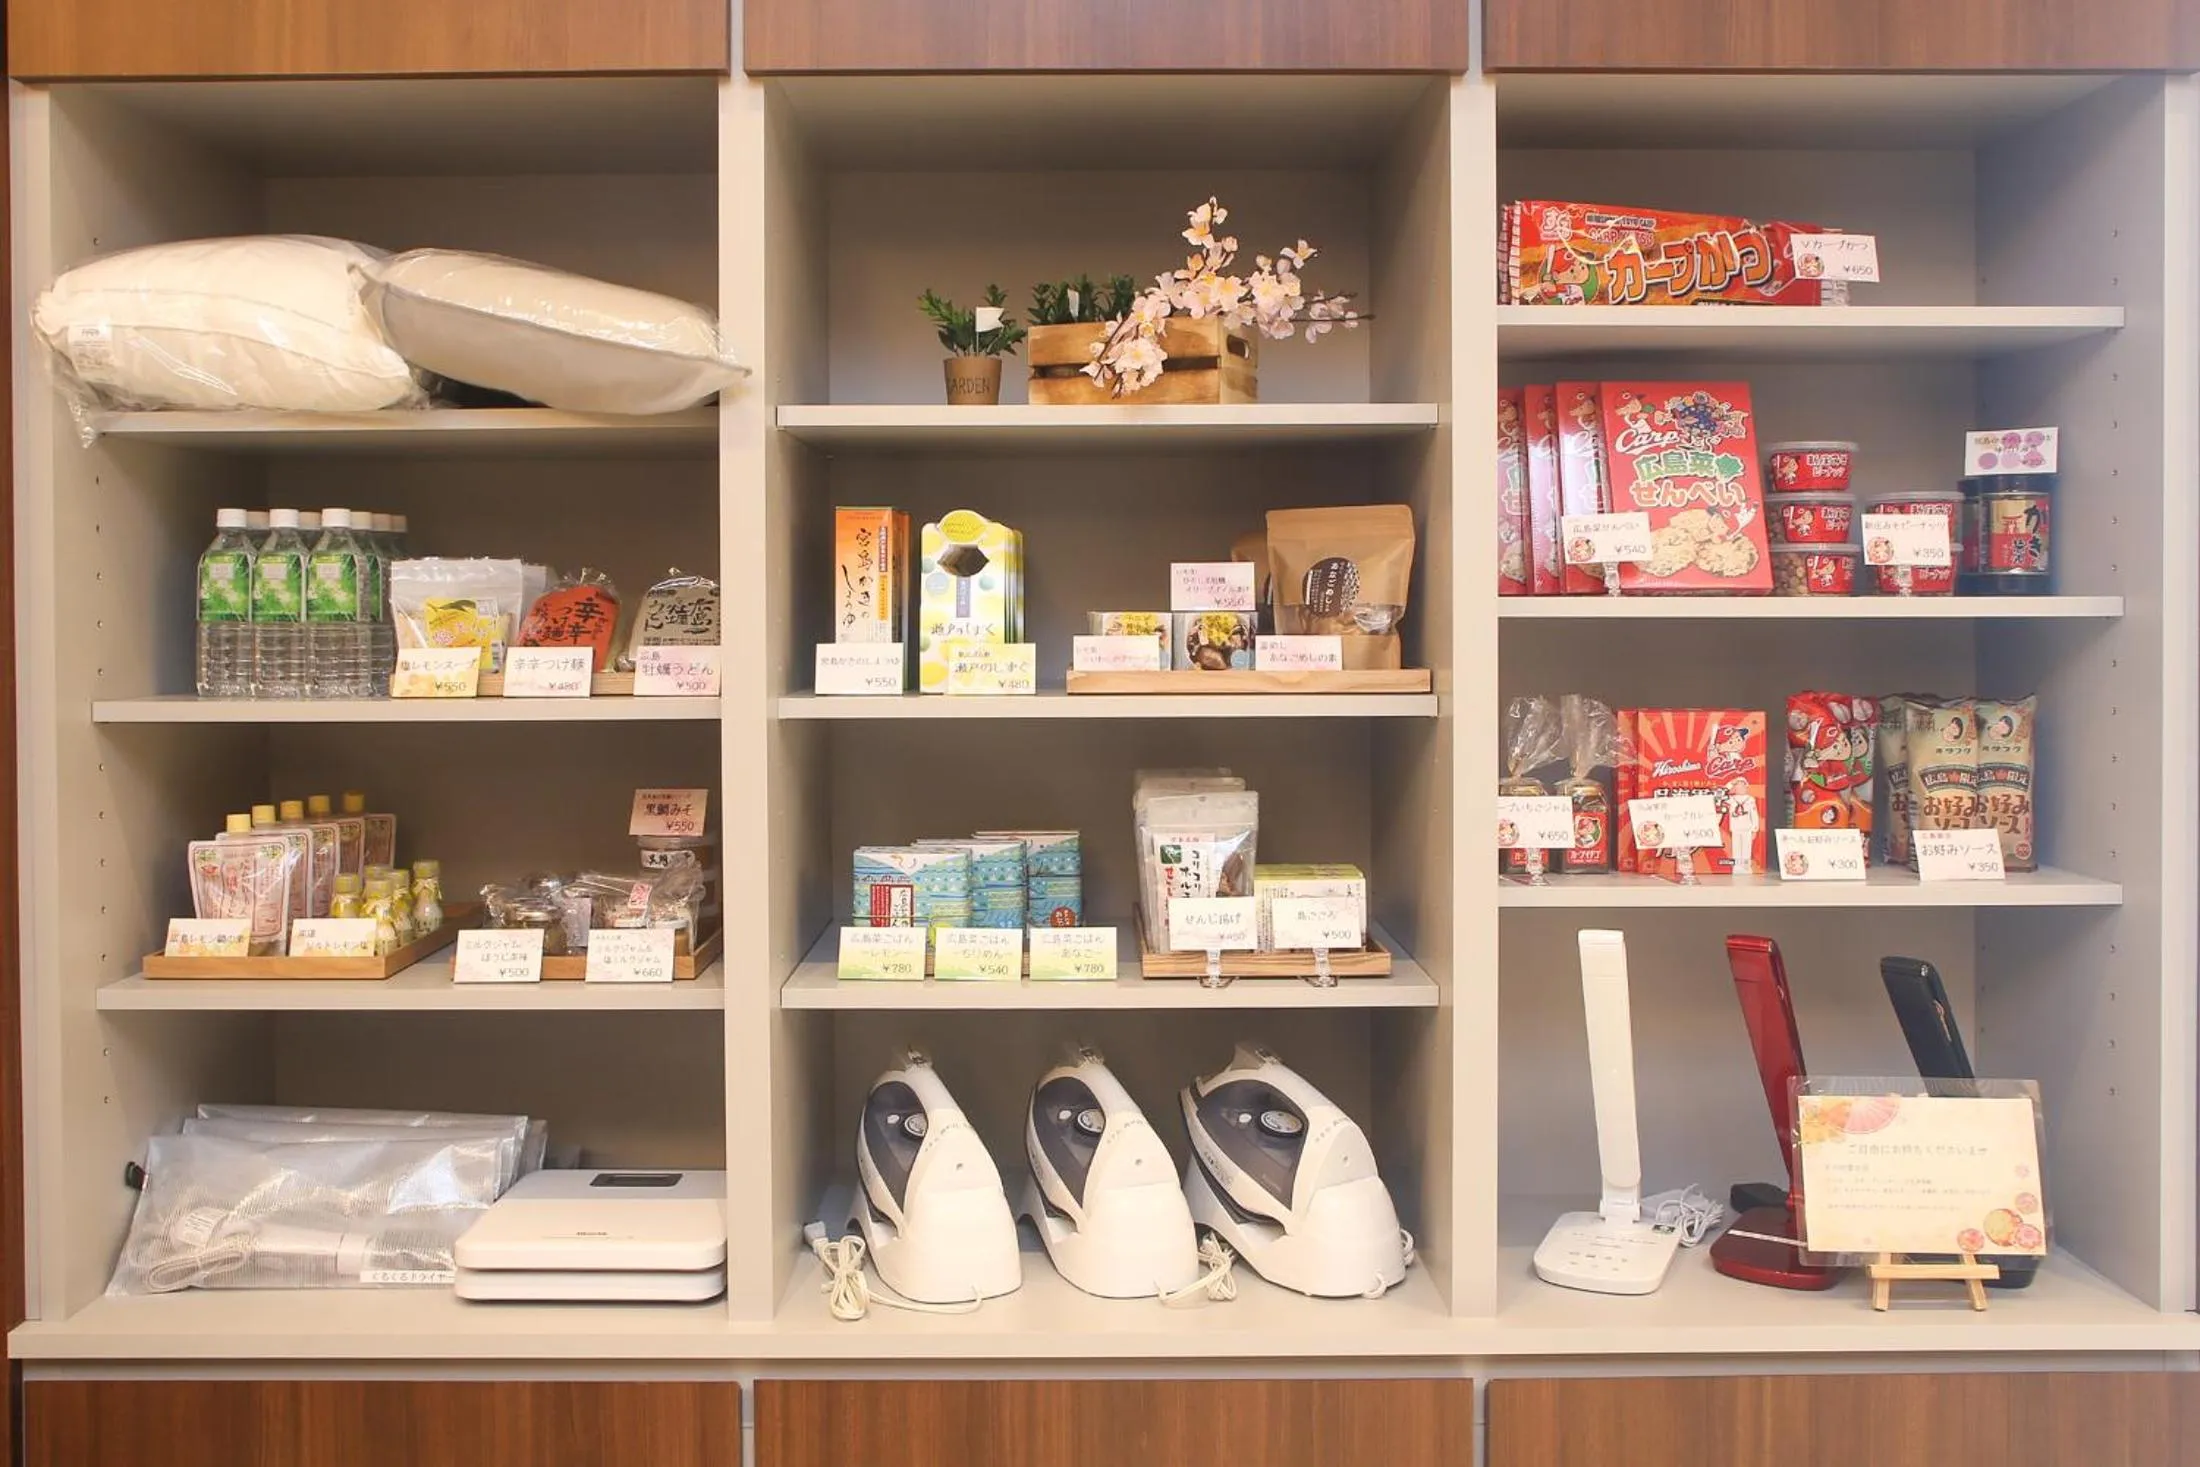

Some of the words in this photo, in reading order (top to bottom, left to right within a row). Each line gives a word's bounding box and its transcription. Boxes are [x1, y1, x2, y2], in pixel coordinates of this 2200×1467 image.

[1606, 230, 1773, 304] カープかつ
[1614, 429, 1681, 455] Carp
[1633, 450, 1716, 483] 広島菜
[1629, 479, 1745, 507] せんべい
[865, 677, 897, 687] ¥550
[1923, 795, 1978, 816] お好み
[666, 820, 694, 831] ¥550
[1922, 844, 1998, 857] お好みソース
[1968, 862, 1999, 872] ¥350
[978, 965, 1009, 975] ¥540
